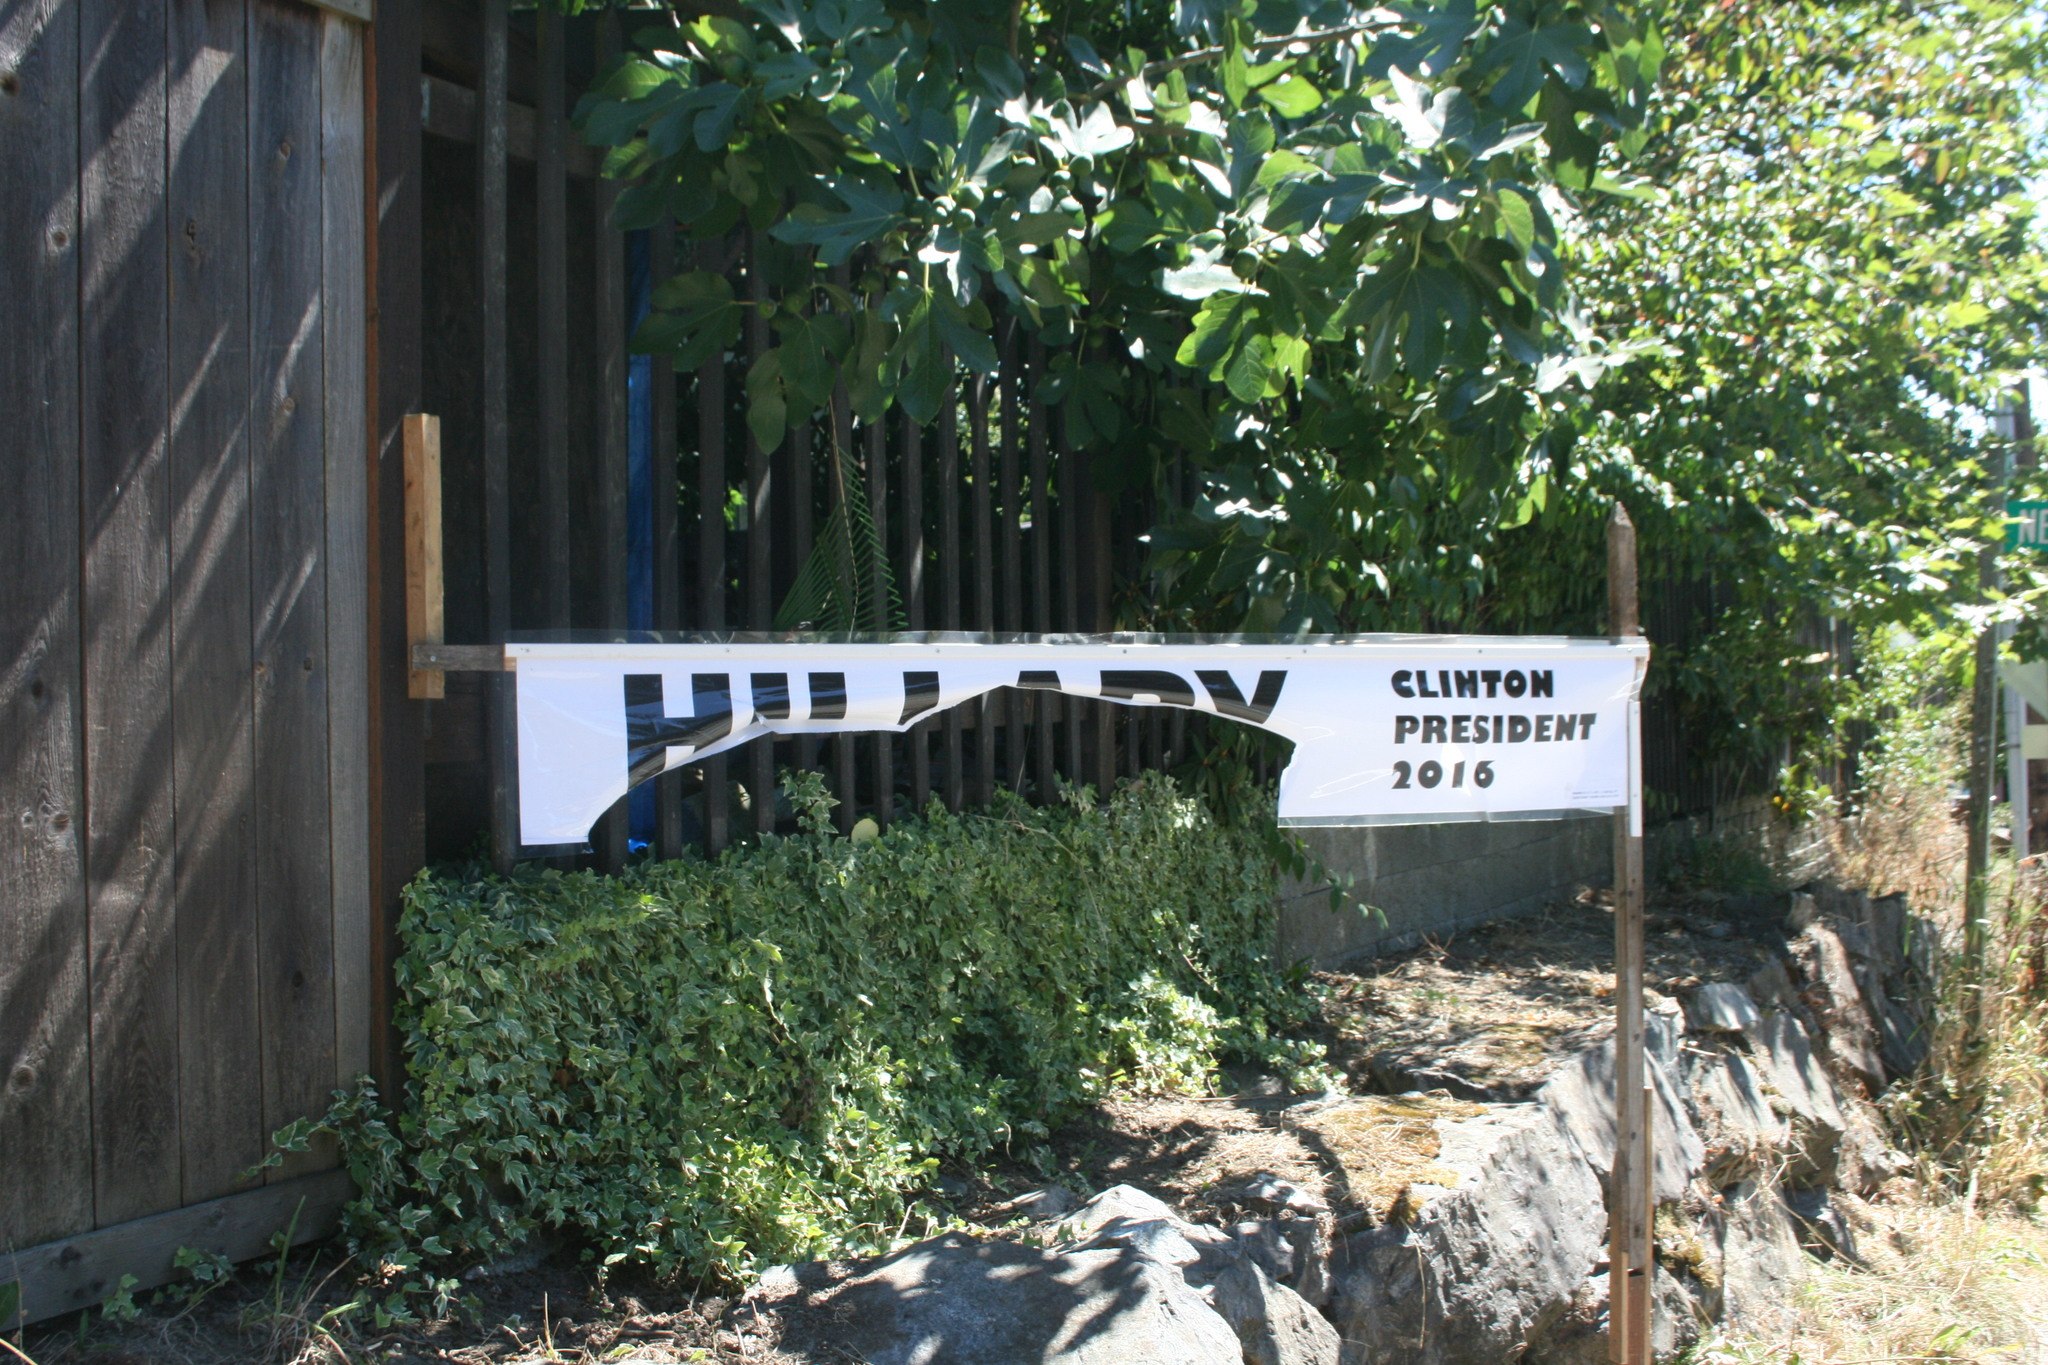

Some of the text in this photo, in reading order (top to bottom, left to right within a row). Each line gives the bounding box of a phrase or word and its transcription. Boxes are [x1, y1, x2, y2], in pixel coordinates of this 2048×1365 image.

[1391, 669, 1554, 698] CLINTON
[1394, 713, 1598, 744] PRESIDENT
[1391, 760, 1495, 789] 2016
